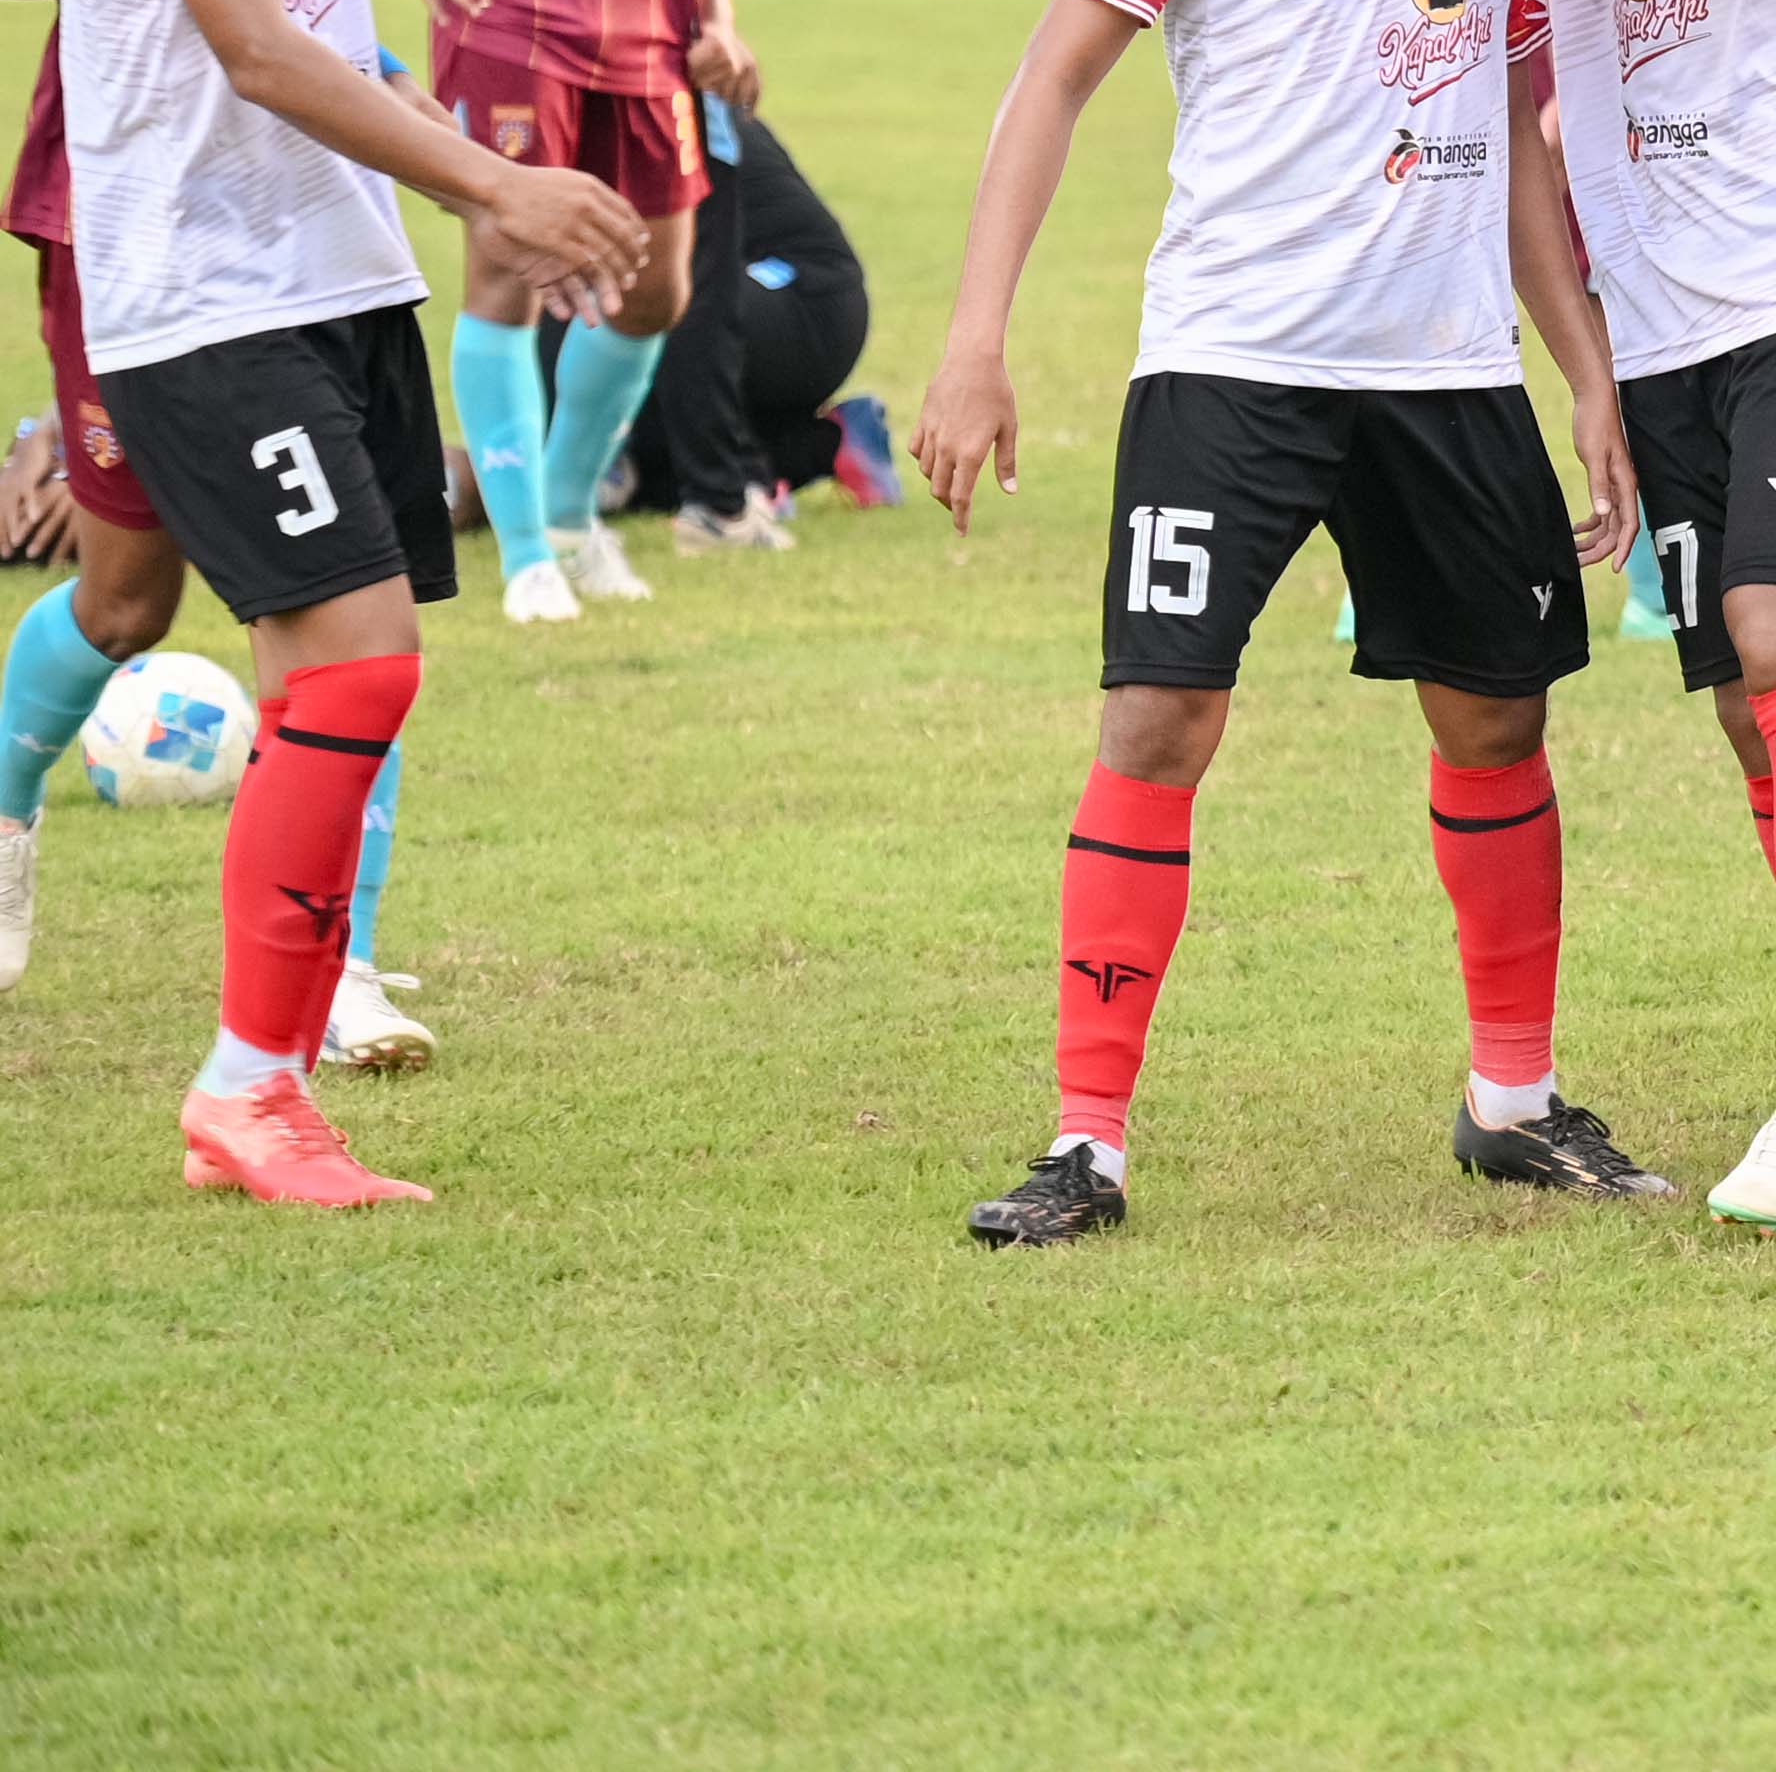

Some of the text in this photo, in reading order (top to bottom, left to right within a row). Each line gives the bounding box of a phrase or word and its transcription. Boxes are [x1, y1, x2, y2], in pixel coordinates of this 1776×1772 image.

[1377, 2, 1494, 91] Kapal Api
[1418, 141, 1488, 169] mangga
[250, 424, 340, 537] 3
[1127, 506, 1215, 617] 15
[1654, 520, 1699, 632] 7
